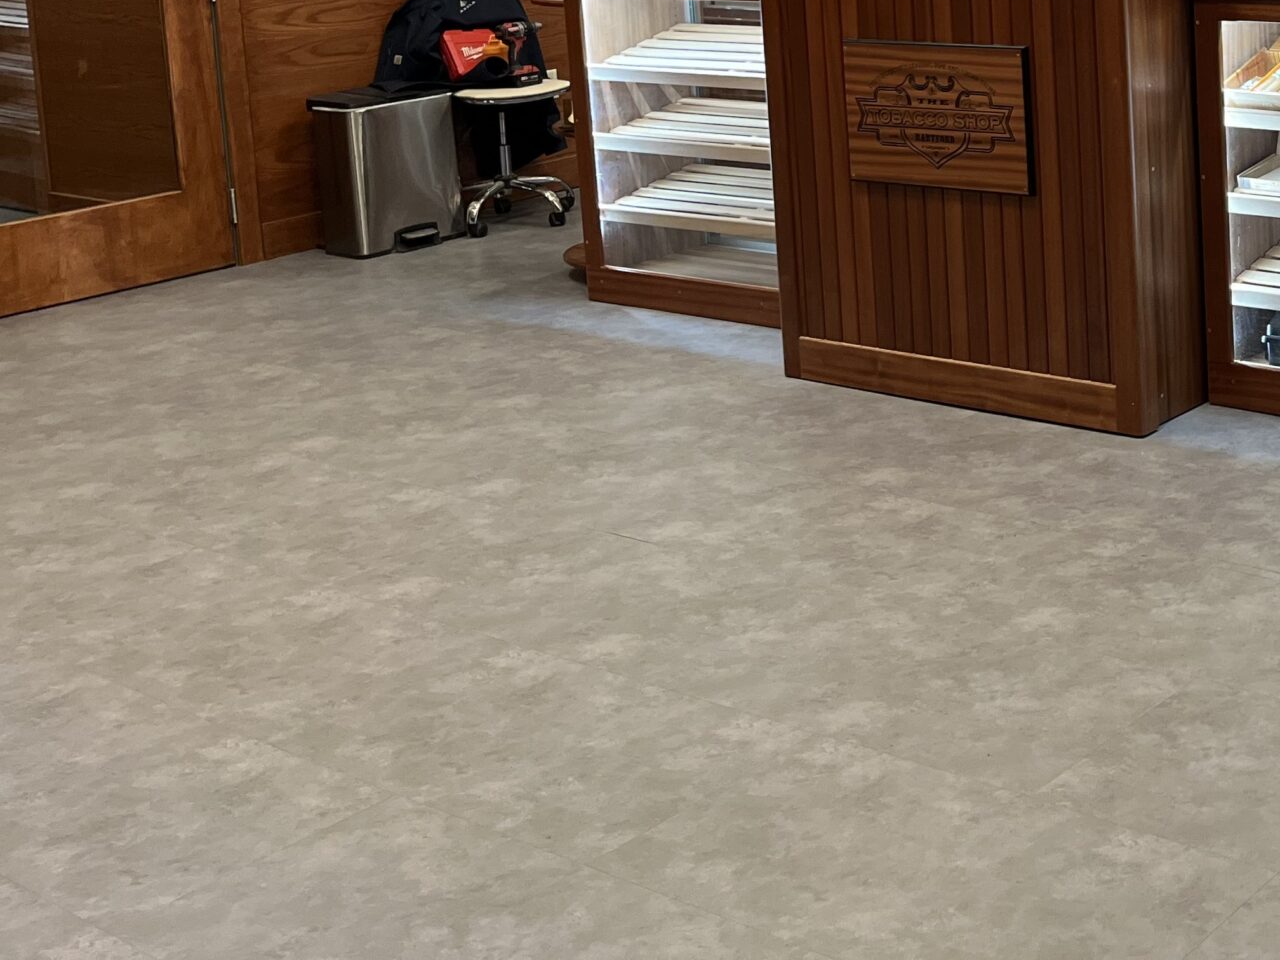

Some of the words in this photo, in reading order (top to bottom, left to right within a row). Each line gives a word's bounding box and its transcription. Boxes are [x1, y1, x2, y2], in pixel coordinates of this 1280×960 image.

[917, 97, 950, 106] THE
[867, 107, 948, 126] TOBACCO
[953, 115, 1002, 130] SHOP
